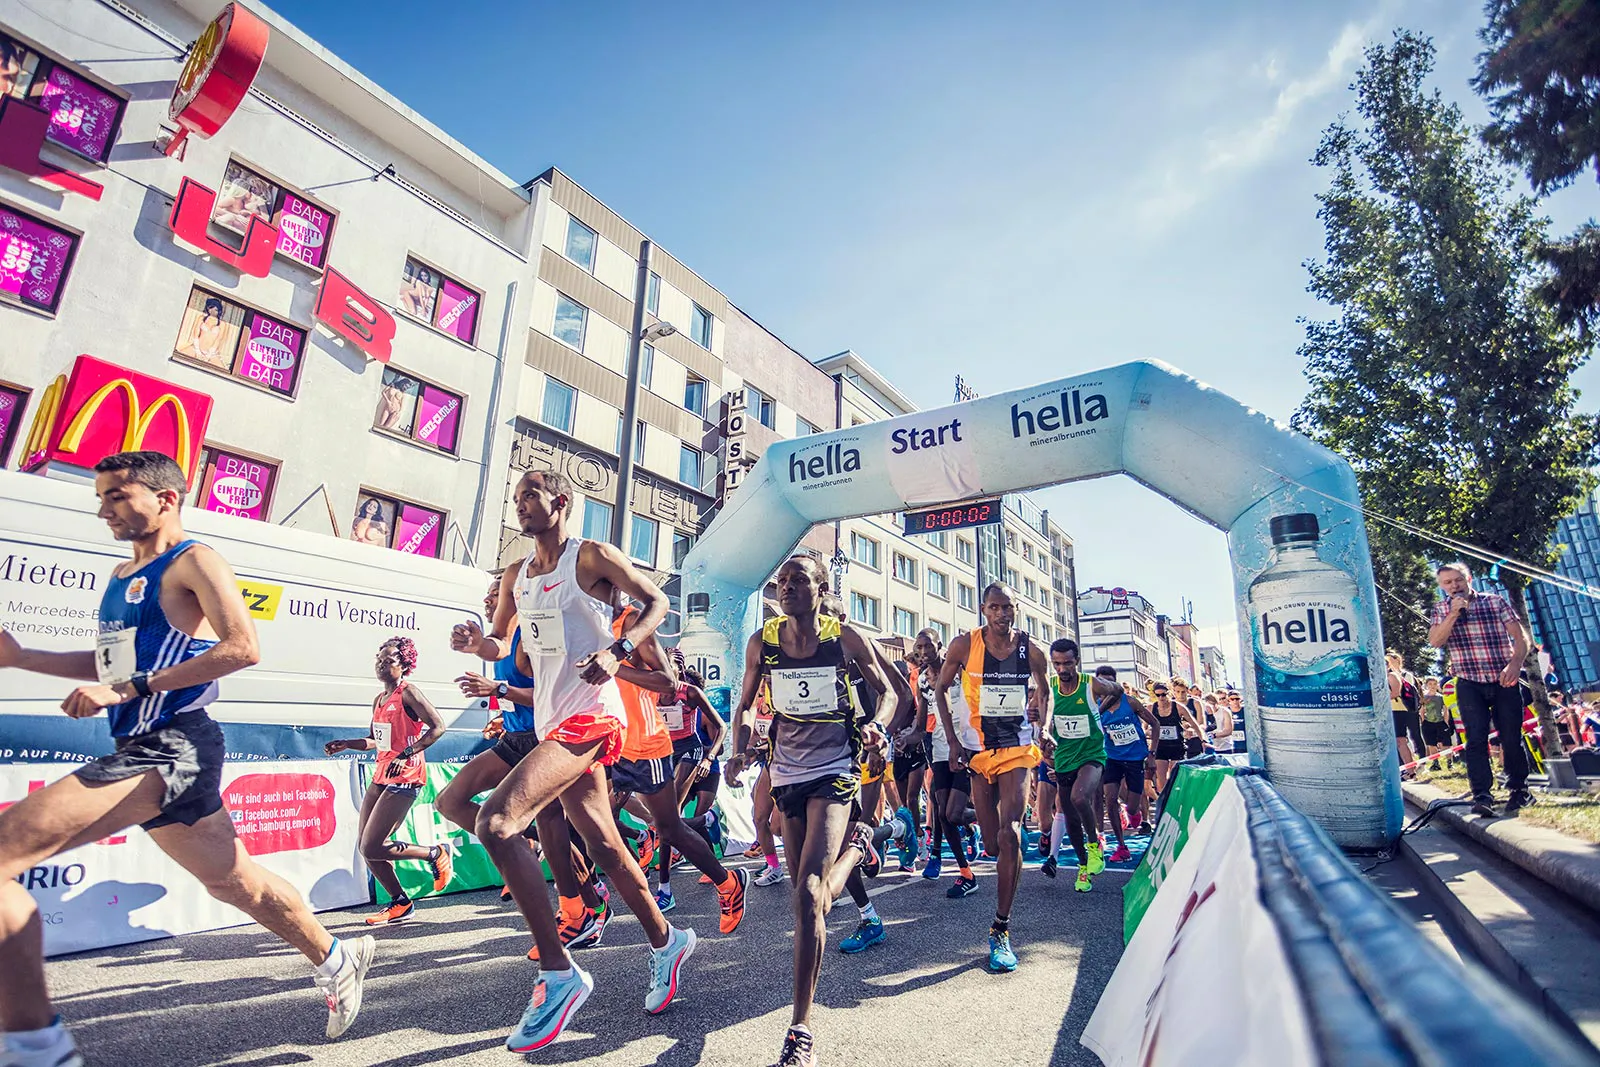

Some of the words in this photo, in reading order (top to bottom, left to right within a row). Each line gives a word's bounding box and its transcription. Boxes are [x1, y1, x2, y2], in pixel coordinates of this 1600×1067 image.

[291, 199, 323, 226] BAR
[282, 219, 321, 240] EINTRITT
[293, 231, 312, 244] FREI
[281, 237, 314, 265] BAR
[260, 320, 294, 345] BAR
[250, 342, 291, 361] EINTRITT
[261, 354, 281, 366] FREI
[248, 362, 284, 388] BAR
[1011, 390, 1109, 438] hella
[891, 418, 962, 454] Start
[1029, 428, 1097, 447] mineralbrunnen
[225, 459, 260, 482] BAR
[789, 443, 861, 483] hella
[217, 485, 260, 499] EINTRITT
[802, 477, 853, 491] mineralbrunnen
[229, 495, 249, 506] FREI
[925, 505, 991, 529] 0:00:02
[289, 599, 328, 619] und
[337, 600, 421, 631] Verstand.
[1323, 602, 1346, 611] FRISCH
[530, 621, 539, 639] 9
[1262, 608, 1351, 645] hella
[783, 671, 800, 679] hella
[798, 680, 810, 698] 3
[1321, 692, 1358, 702] classic
[998, 694, 1007, 706] 7
[1065, 721, 1078, 731] 17
[1113, 728, 1136, 741] 10716
[20, 749, 49, 758] AUF
[54, 751, 99, 764] FRISC
[229, 793, 243, 805] Wir
[245, 792, 262, 803] sind
[264, 791, 280, 802] auch
[283, 791, 294, 801] bei
[296, 789, 329, 800] Facebook:
[245, 805, 302, 821] facebook.com/
